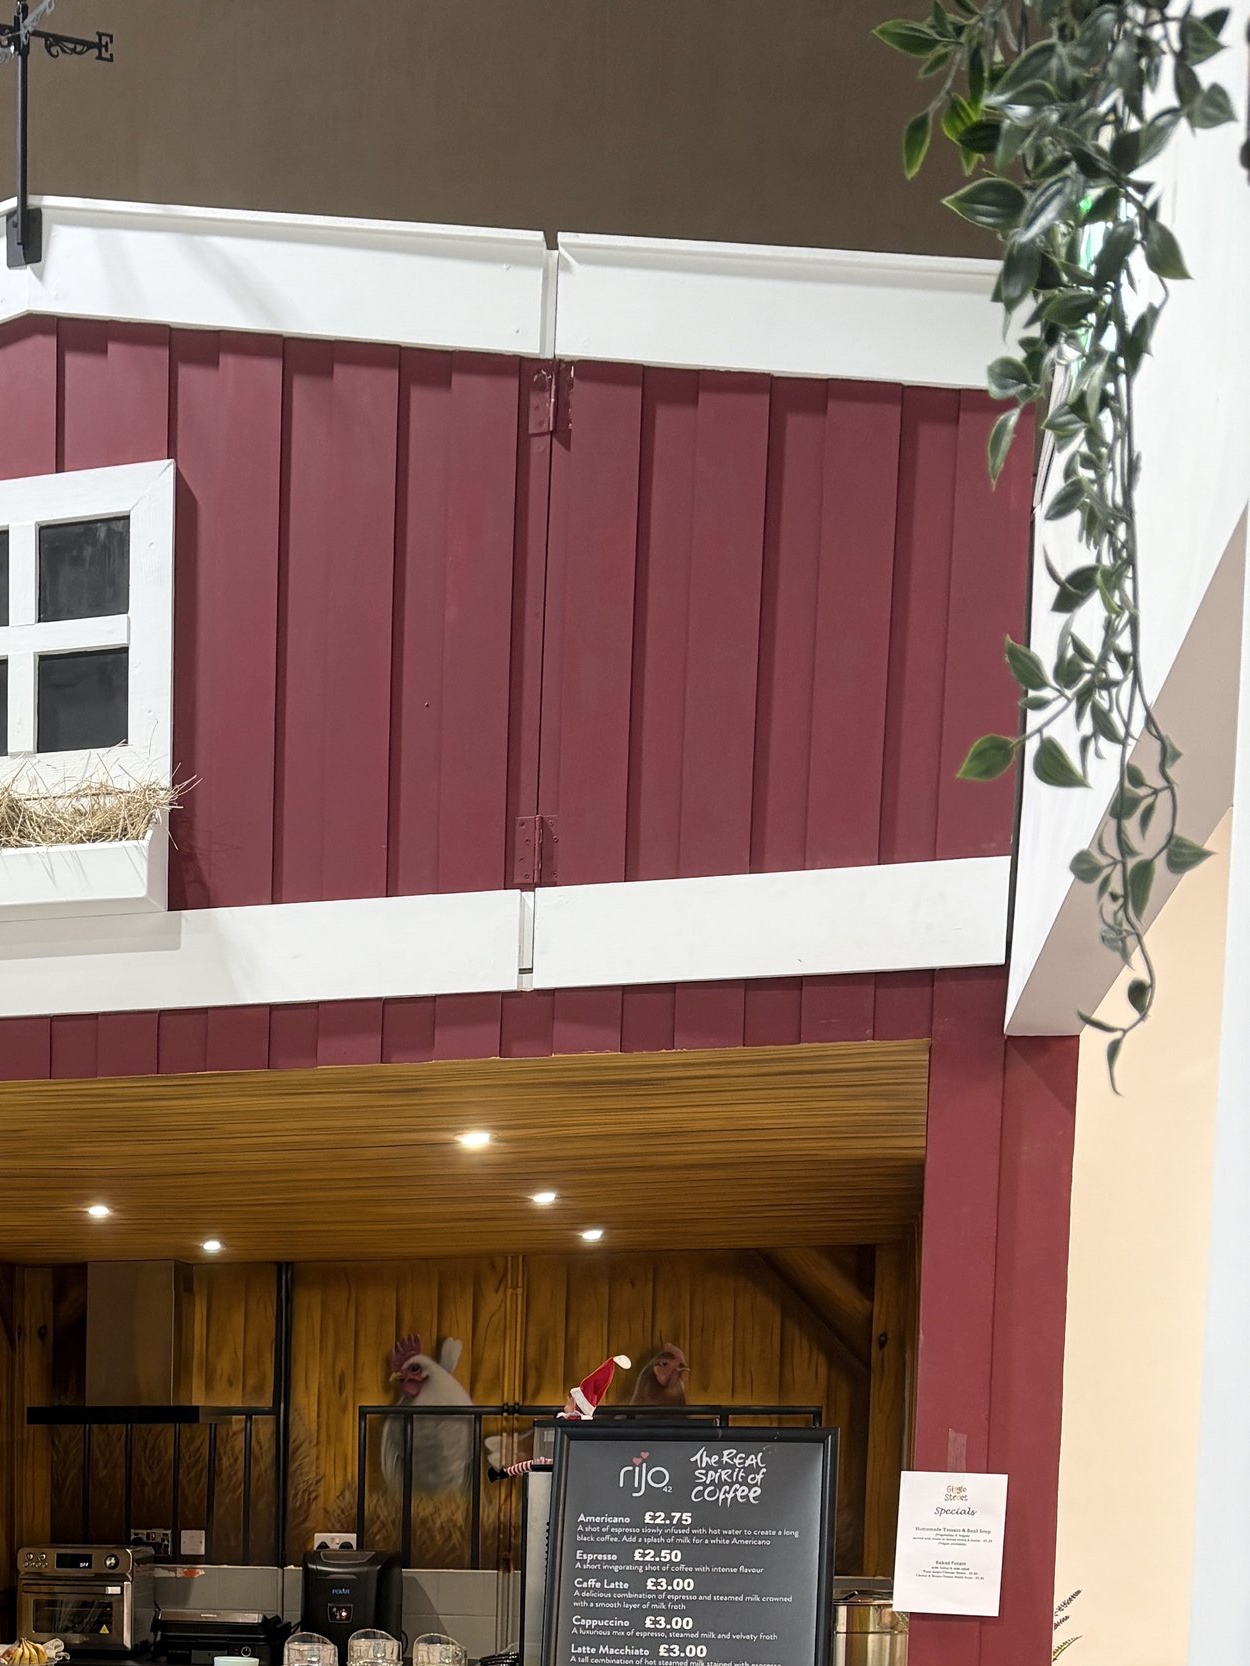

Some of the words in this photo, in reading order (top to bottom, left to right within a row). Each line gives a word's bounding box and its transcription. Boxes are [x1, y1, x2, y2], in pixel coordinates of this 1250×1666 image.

[96, 31, 113, 62] E
[690, 1446, 719, 1468] The
[619, 1460, 670, 1497] rijo
[747, 1468, 767, 1485] of
[577, 1513, 630, 1523] Americano
[644, 1512, 692, 1524] £2.75
[934, 1507, 977, 1517] Specials
[610, 1527, 640, 1535] espresso
[642, 1526, 663, 1535] slowly
[664, 1526, 690, 1534] infused
[783, 1529, 799, 1538] long
[644, 1536, 665, 1544] splash
[710, 1537, 730, 1545] white
[576, 1550, 617, 1563] Espresso
[634, 1549, 682, 1562] £2.50
[602, 1563, 643, 1573] invigorating
[671, 1564, 693, 1572] coffee
[739, 1565, 764, 1573] flavour
[574, 1578, 601, 1589] Caffe
[604, 1579, 629, 1589] Latte
[646, 1578, 694, 1591] £3.00
[581, 1590, 611, 1598] delicious
[613, 1591, 656, 1599] combination
[713, 1594, 744, 1602] steamed
[745, 1594, 760, 1602] milk
[623, 1602, 640, 1610] layer
[668, 1602, 686, 1610] froth
[572, 1615, 630, 1629] Cappuccino
[645, 1616, 693, 1629] £3.00
[635, 1631, 668, 1639] espresso,
[732, 1632, 758, 1642] velvety
[571, 1643, 596, 1654] Latte
[598, 1644, 650, 1656] Macchiato
[658, 1644, 707, 1658] £3.00
[569, 1655, 577, 1663] A
[590, 1657, 634, 1665] combination
[644, 1658, 656, 1666] hot
